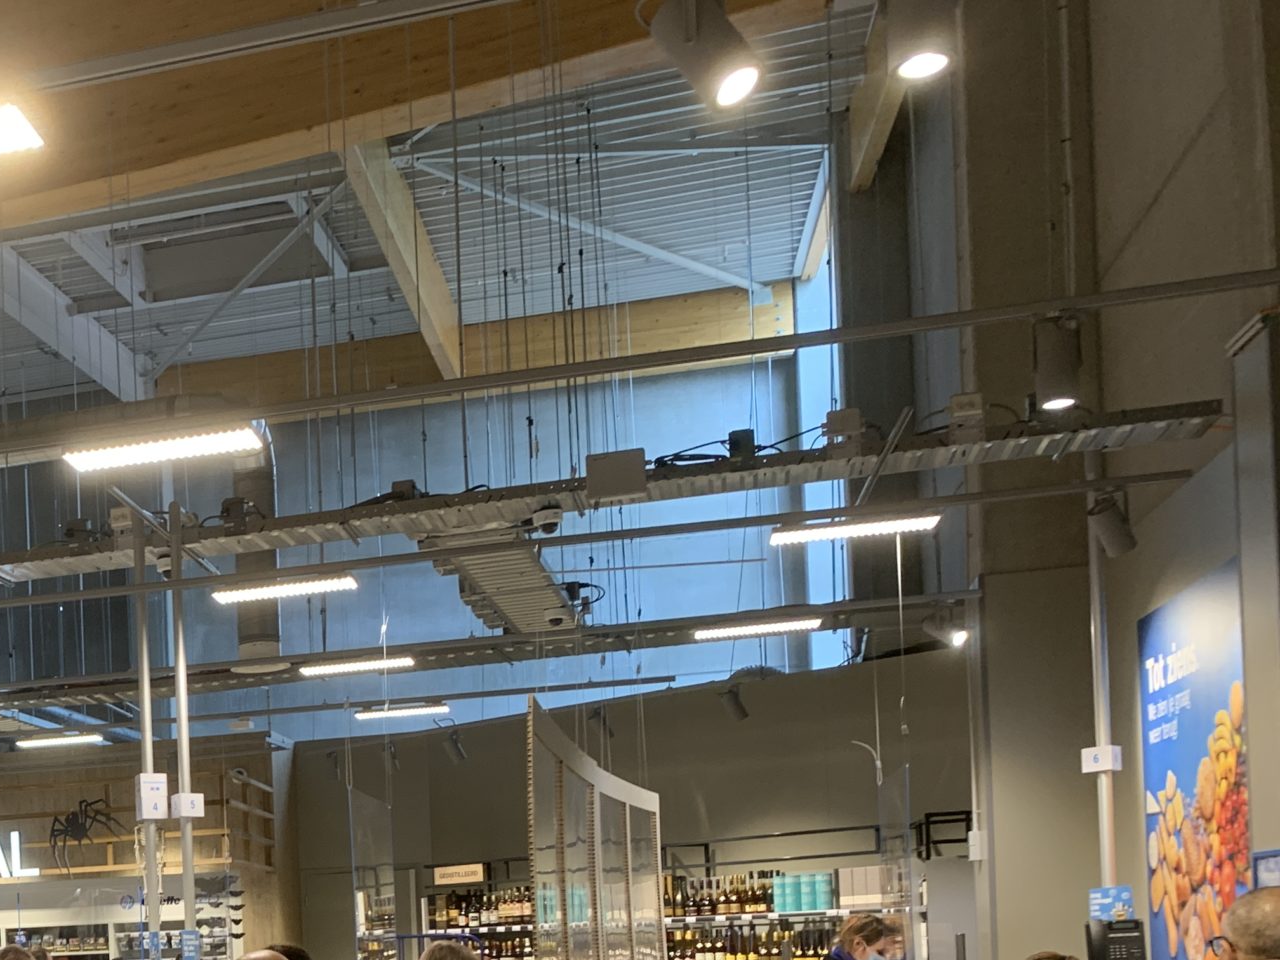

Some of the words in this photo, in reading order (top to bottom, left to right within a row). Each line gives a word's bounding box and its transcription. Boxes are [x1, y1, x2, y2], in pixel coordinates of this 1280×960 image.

[1145, 654, 1165, 693] Tot
[1093, 753, 1100, 764] 6
[152, 802, 158, 812] 4
[190, 799, 196, 810] 5
